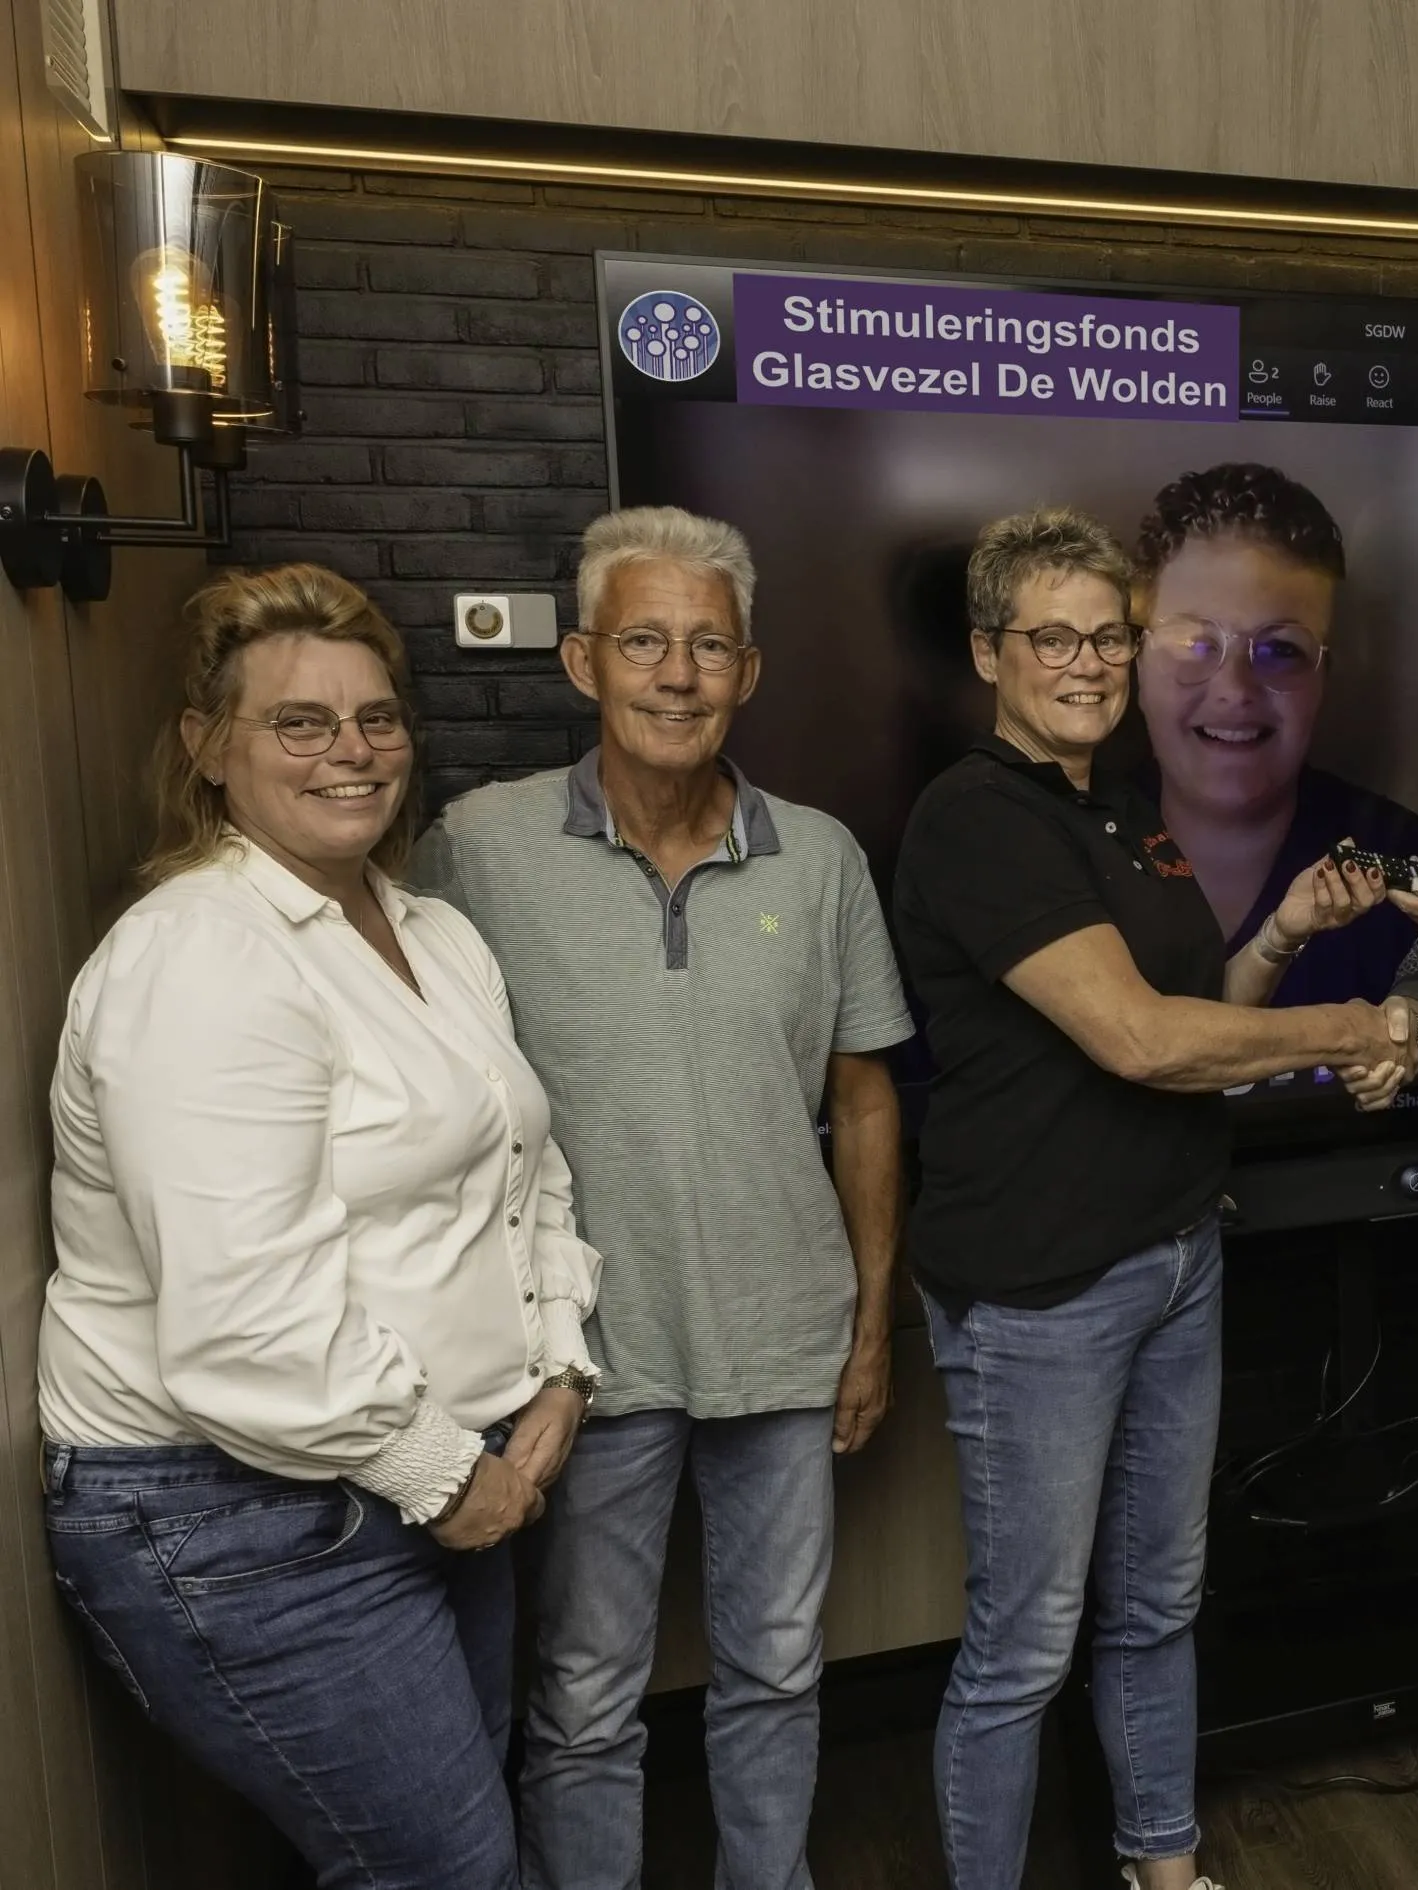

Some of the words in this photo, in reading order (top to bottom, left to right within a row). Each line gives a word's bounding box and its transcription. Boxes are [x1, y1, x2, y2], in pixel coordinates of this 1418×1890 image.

[783, 295, 1200, 354] Stimuleringsfonds
[1365, 324, 1405, 339] SGDW
[752, 351, 980, 396] Glasvezel
[998, 363, 1055, 399] De
[1069, 366, 1227, 407] Wolden
[1271, 368, 1280, 379] 2
[1247, 392, 1283, 407] People
[1309, 395, 1337, 406] Raise
[1366, 397, 1394, 409] React
